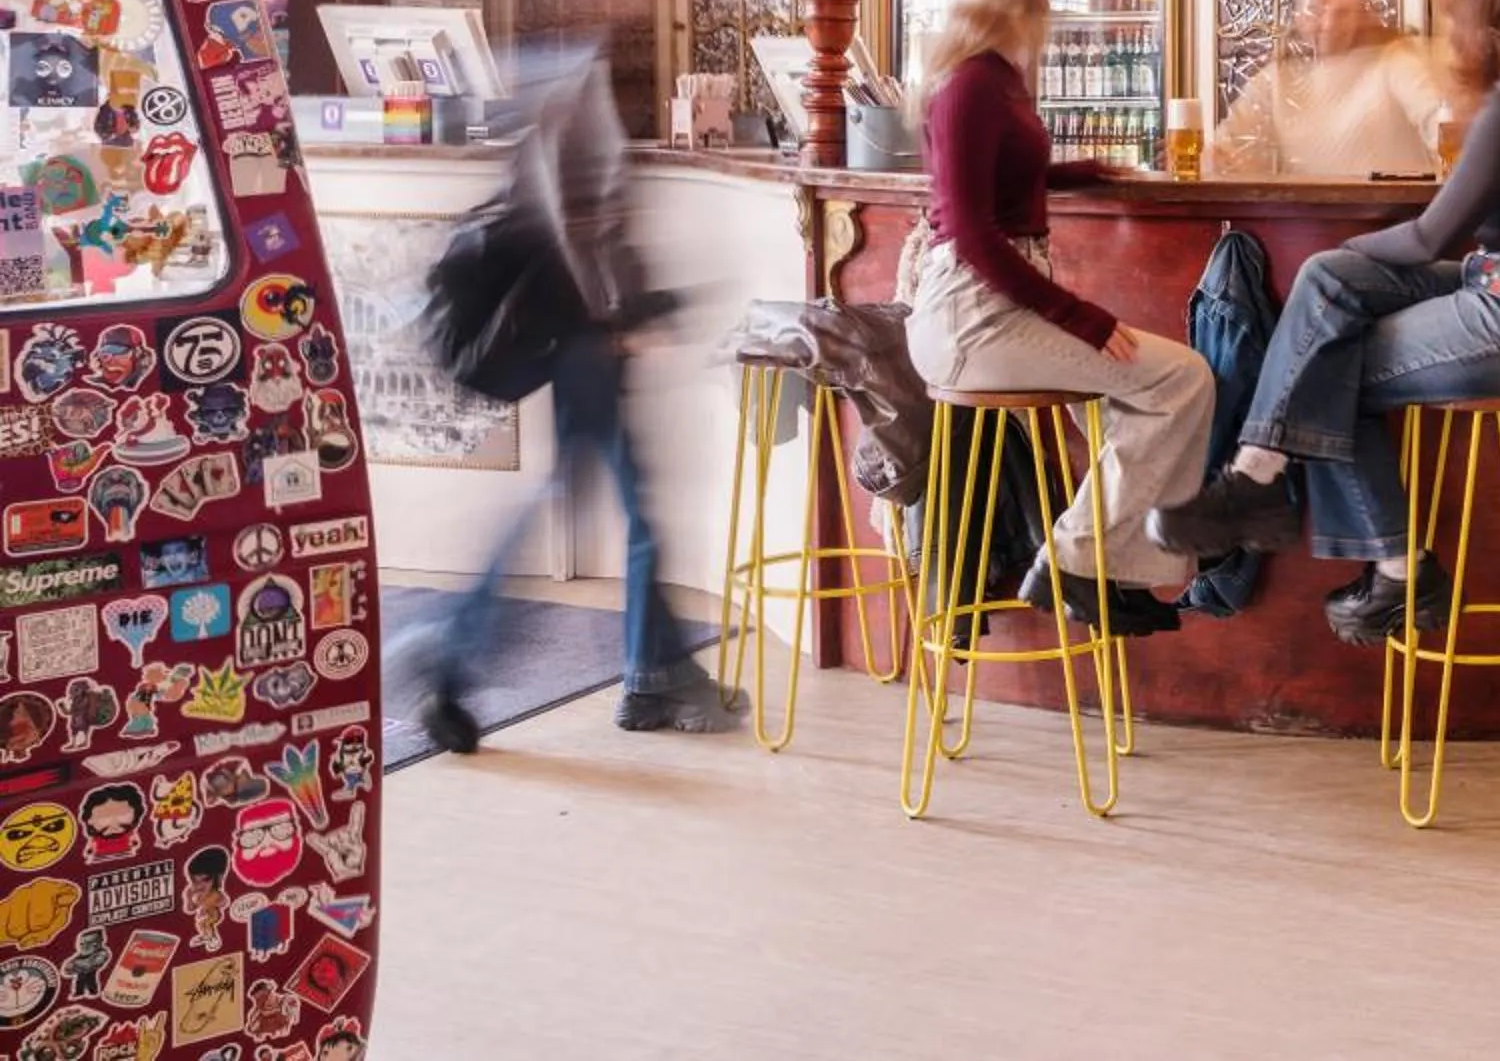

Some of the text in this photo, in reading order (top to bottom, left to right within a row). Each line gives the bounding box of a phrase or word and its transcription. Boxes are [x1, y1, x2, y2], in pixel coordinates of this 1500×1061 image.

[295, 520, 365, 554] yeah!
[5, 564, 118, 595] Supreme
[119, 610, 152, 627] DIE
[93, 877, 170, 915] ADVISORY
